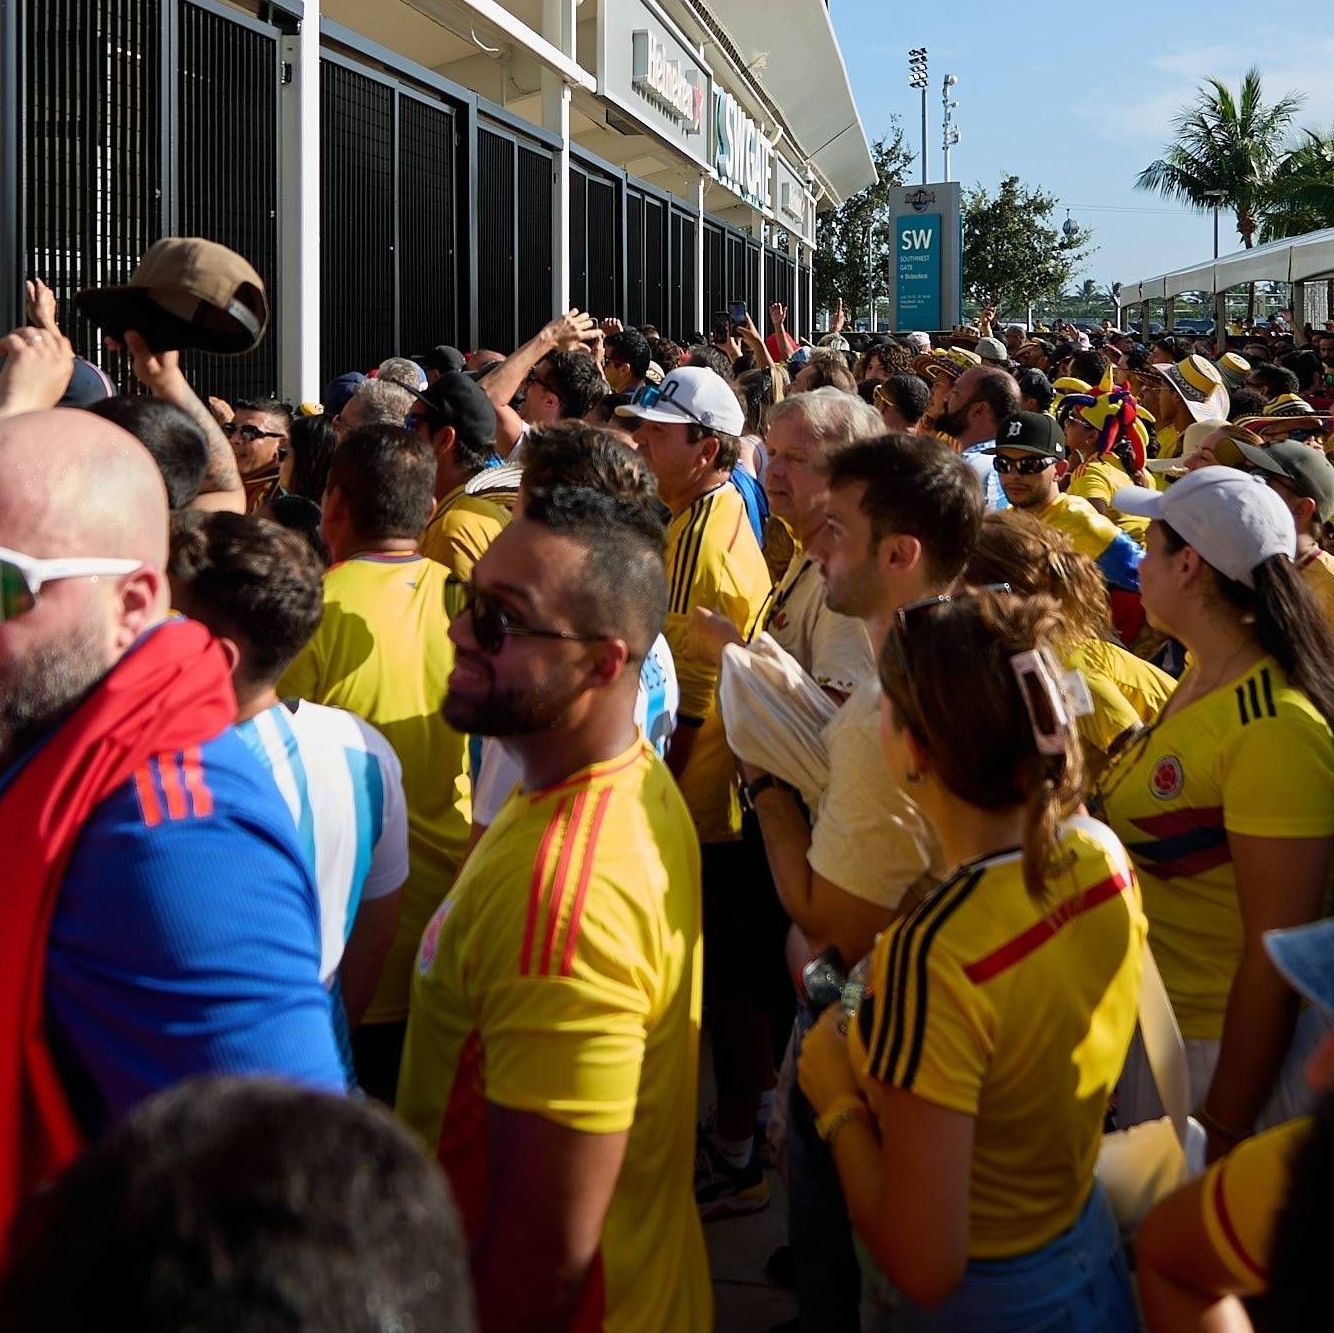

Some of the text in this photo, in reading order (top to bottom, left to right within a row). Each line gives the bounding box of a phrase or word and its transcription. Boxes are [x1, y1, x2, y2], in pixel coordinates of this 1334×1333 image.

[722, 91, 748, 186] SW
[746, 118, 773, 208] GATE
[901, 228, 933, 251] SW
[900, 255, 930, 263] SOUTHWEST
